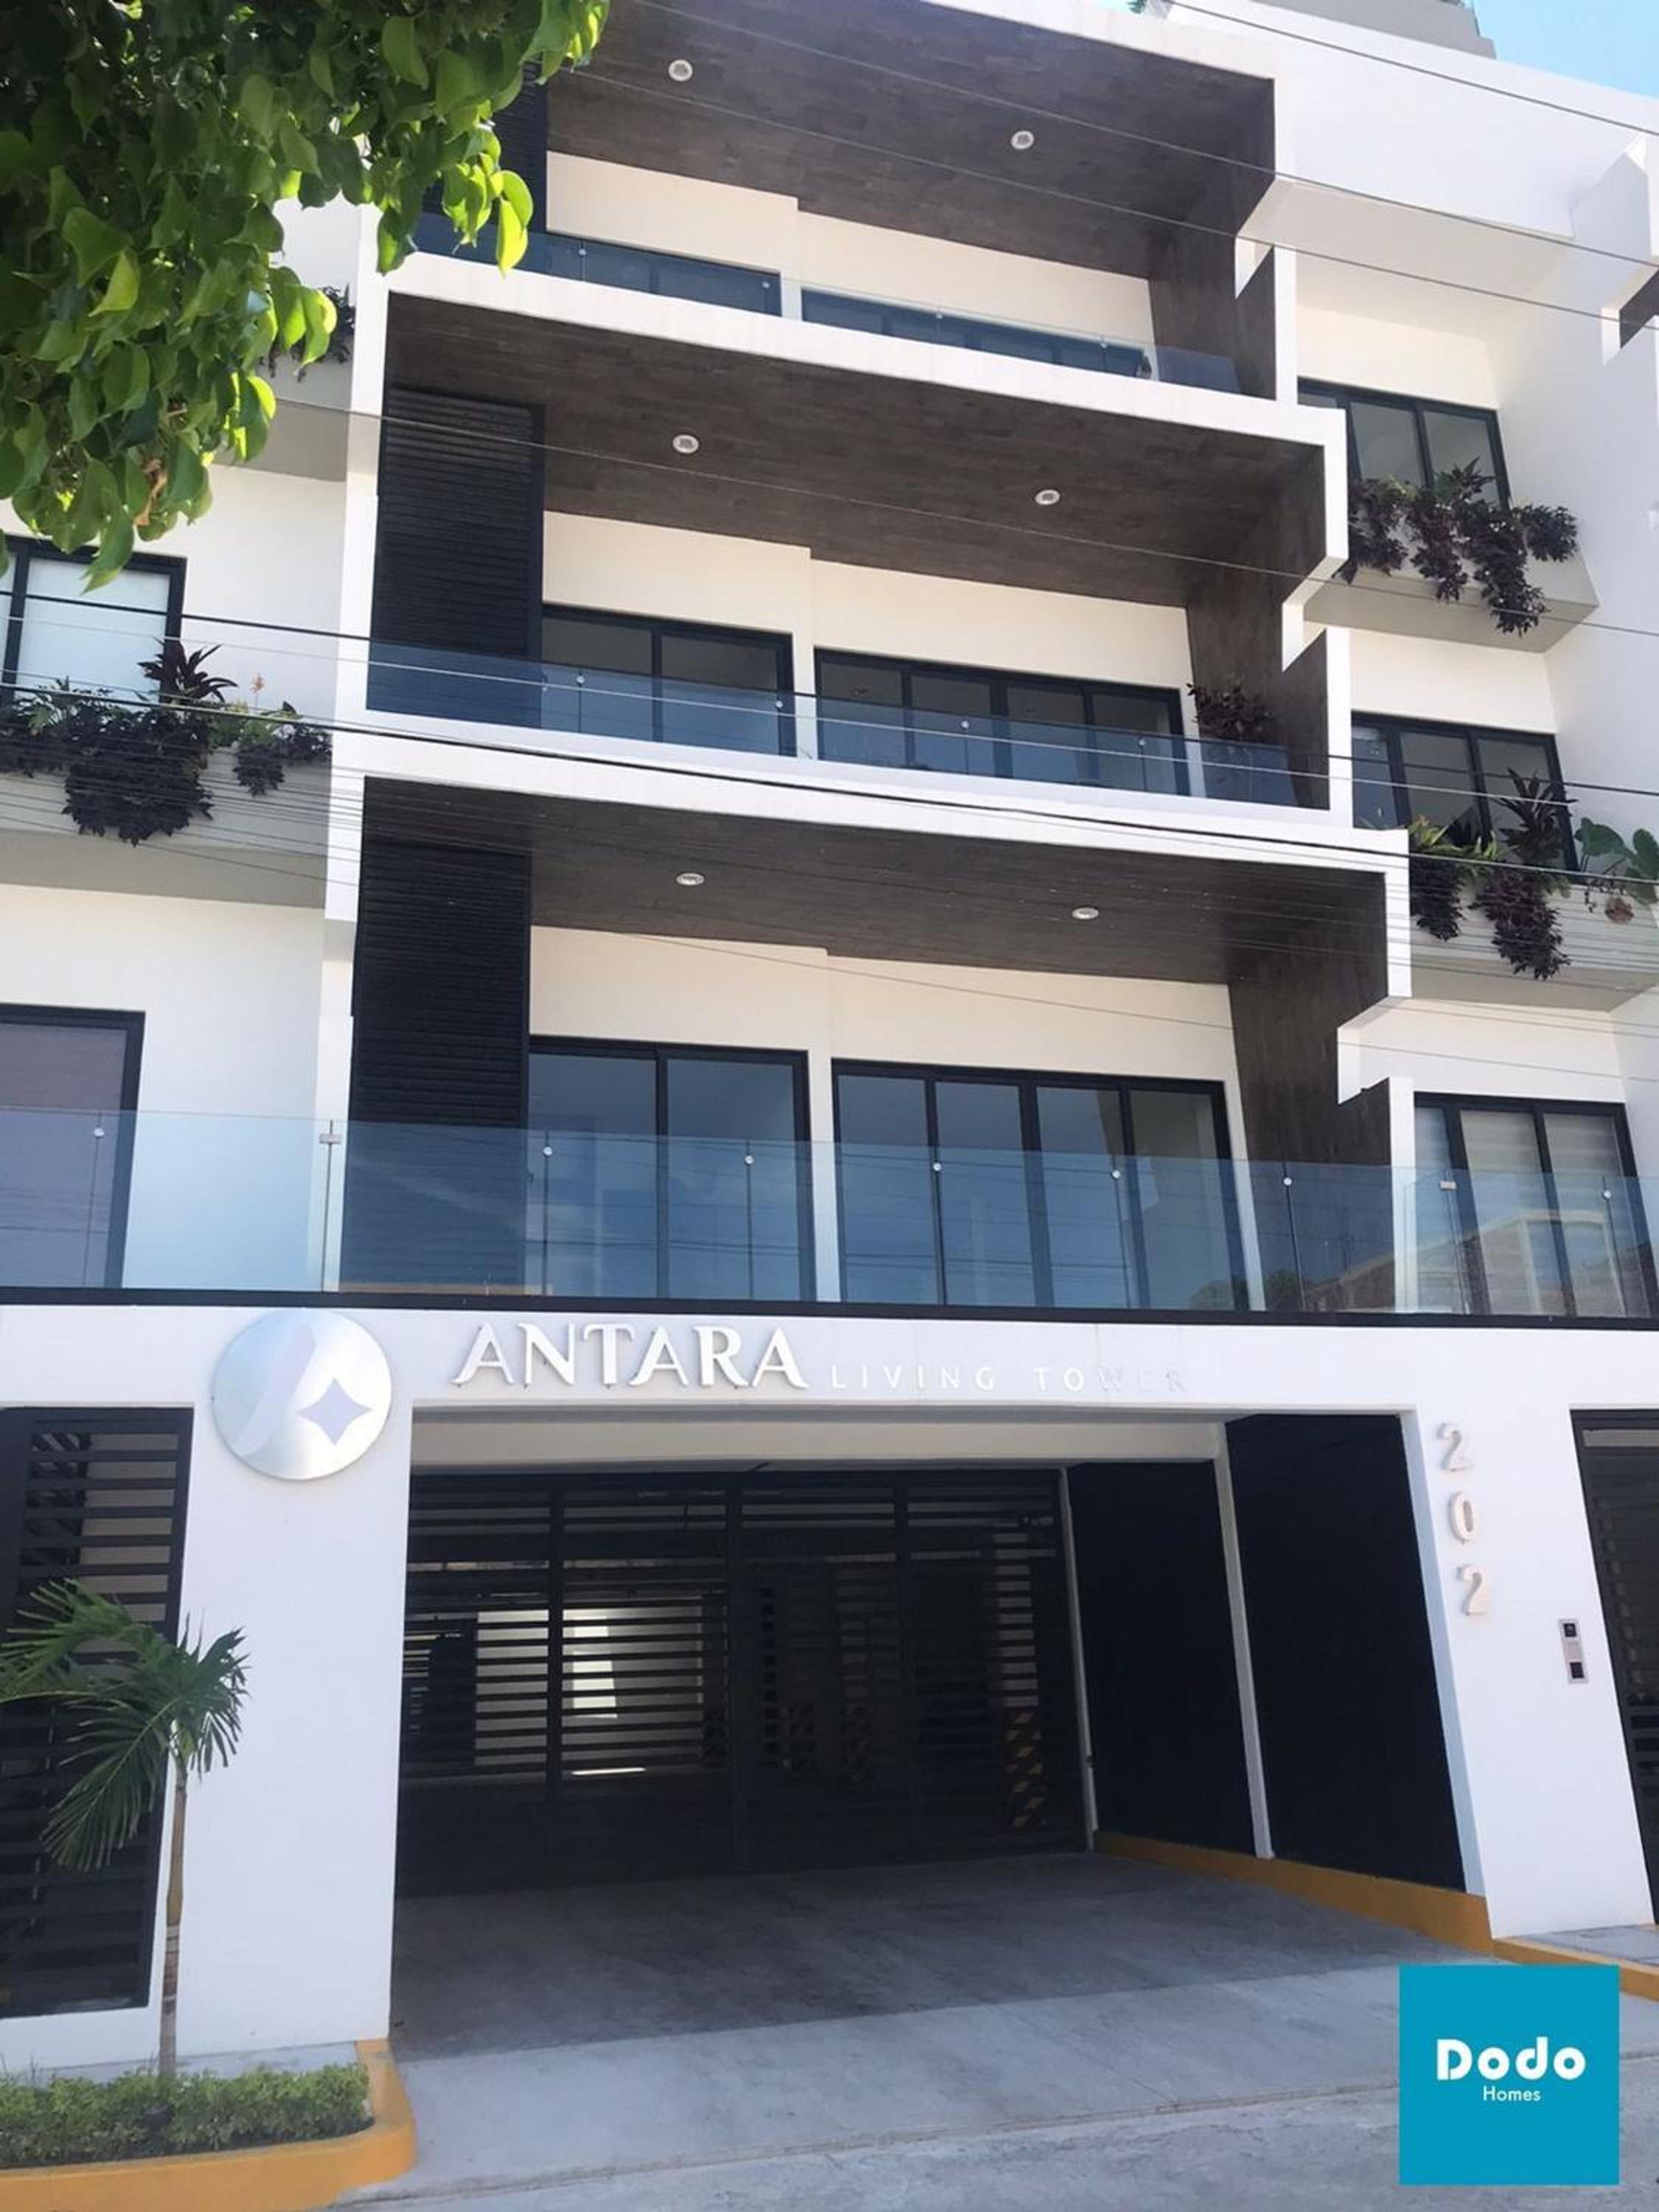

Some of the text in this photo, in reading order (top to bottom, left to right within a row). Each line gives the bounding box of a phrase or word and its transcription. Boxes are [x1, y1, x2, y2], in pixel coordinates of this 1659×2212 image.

[451, 1321, 1189, 1393] ANTARA LIVING TOWER
